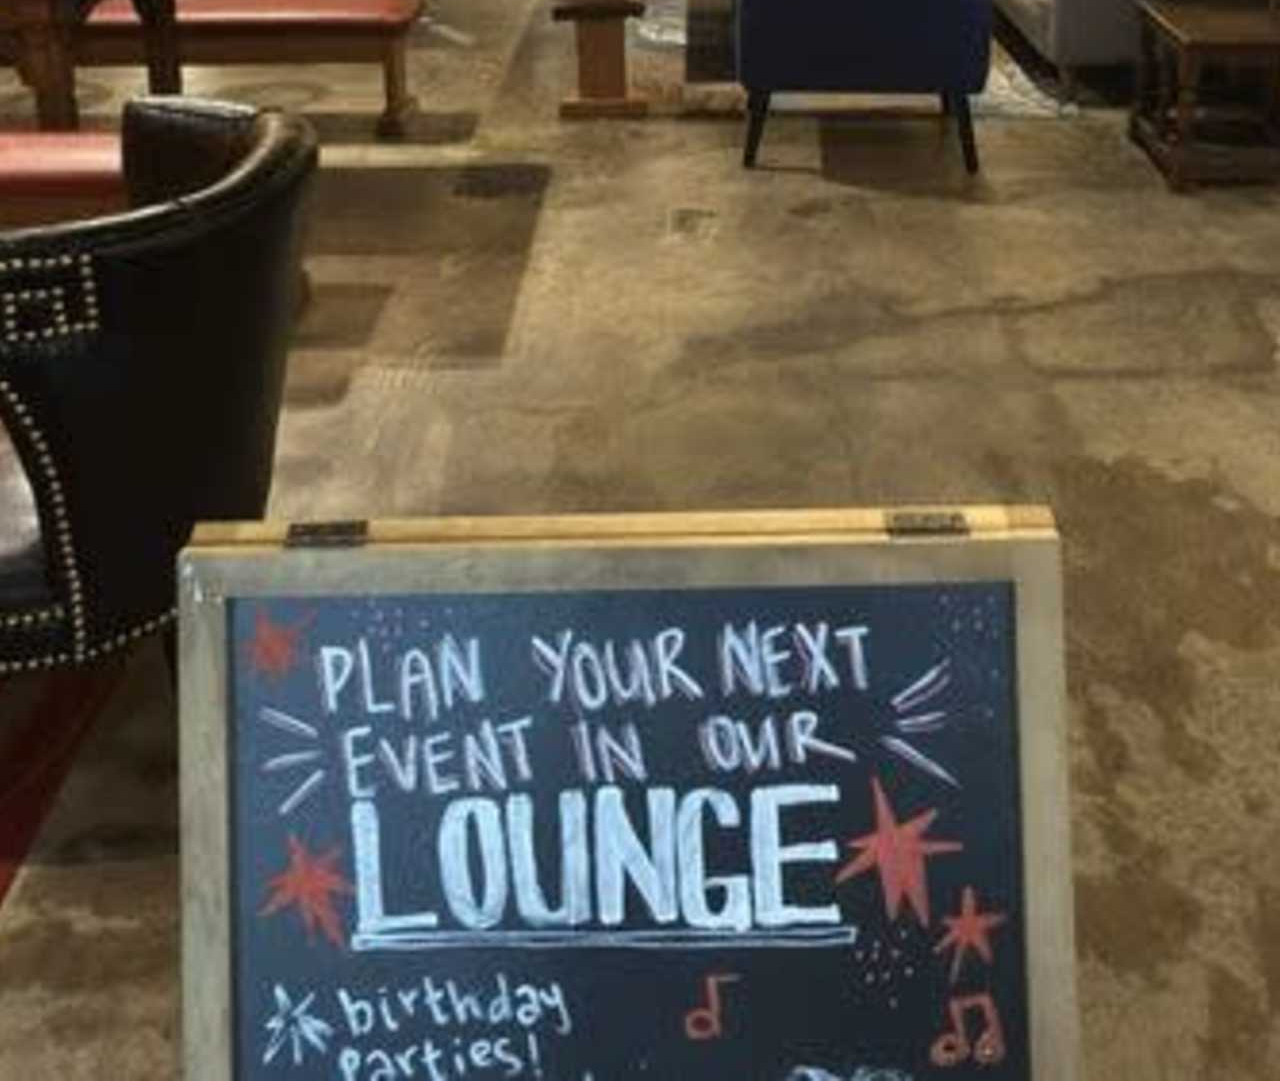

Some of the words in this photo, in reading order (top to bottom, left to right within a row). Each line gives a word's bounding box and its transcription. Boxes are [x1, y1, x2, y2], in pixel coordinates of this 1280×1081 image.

[319, 635, 484, 719] PLAN
[531, 629, 704, 714] YOUR
[718, 622, 870, 698] NEXT
[340, 717, 532, 797] EVENT
[575, 720, 647, 784] IN
[705, 710, 857, 773] OUR
[349, 784, 840, 935] LOUNGE
[336, 973, 572, 1035] birthday
[337, 1032, 543, 1081] parties!
